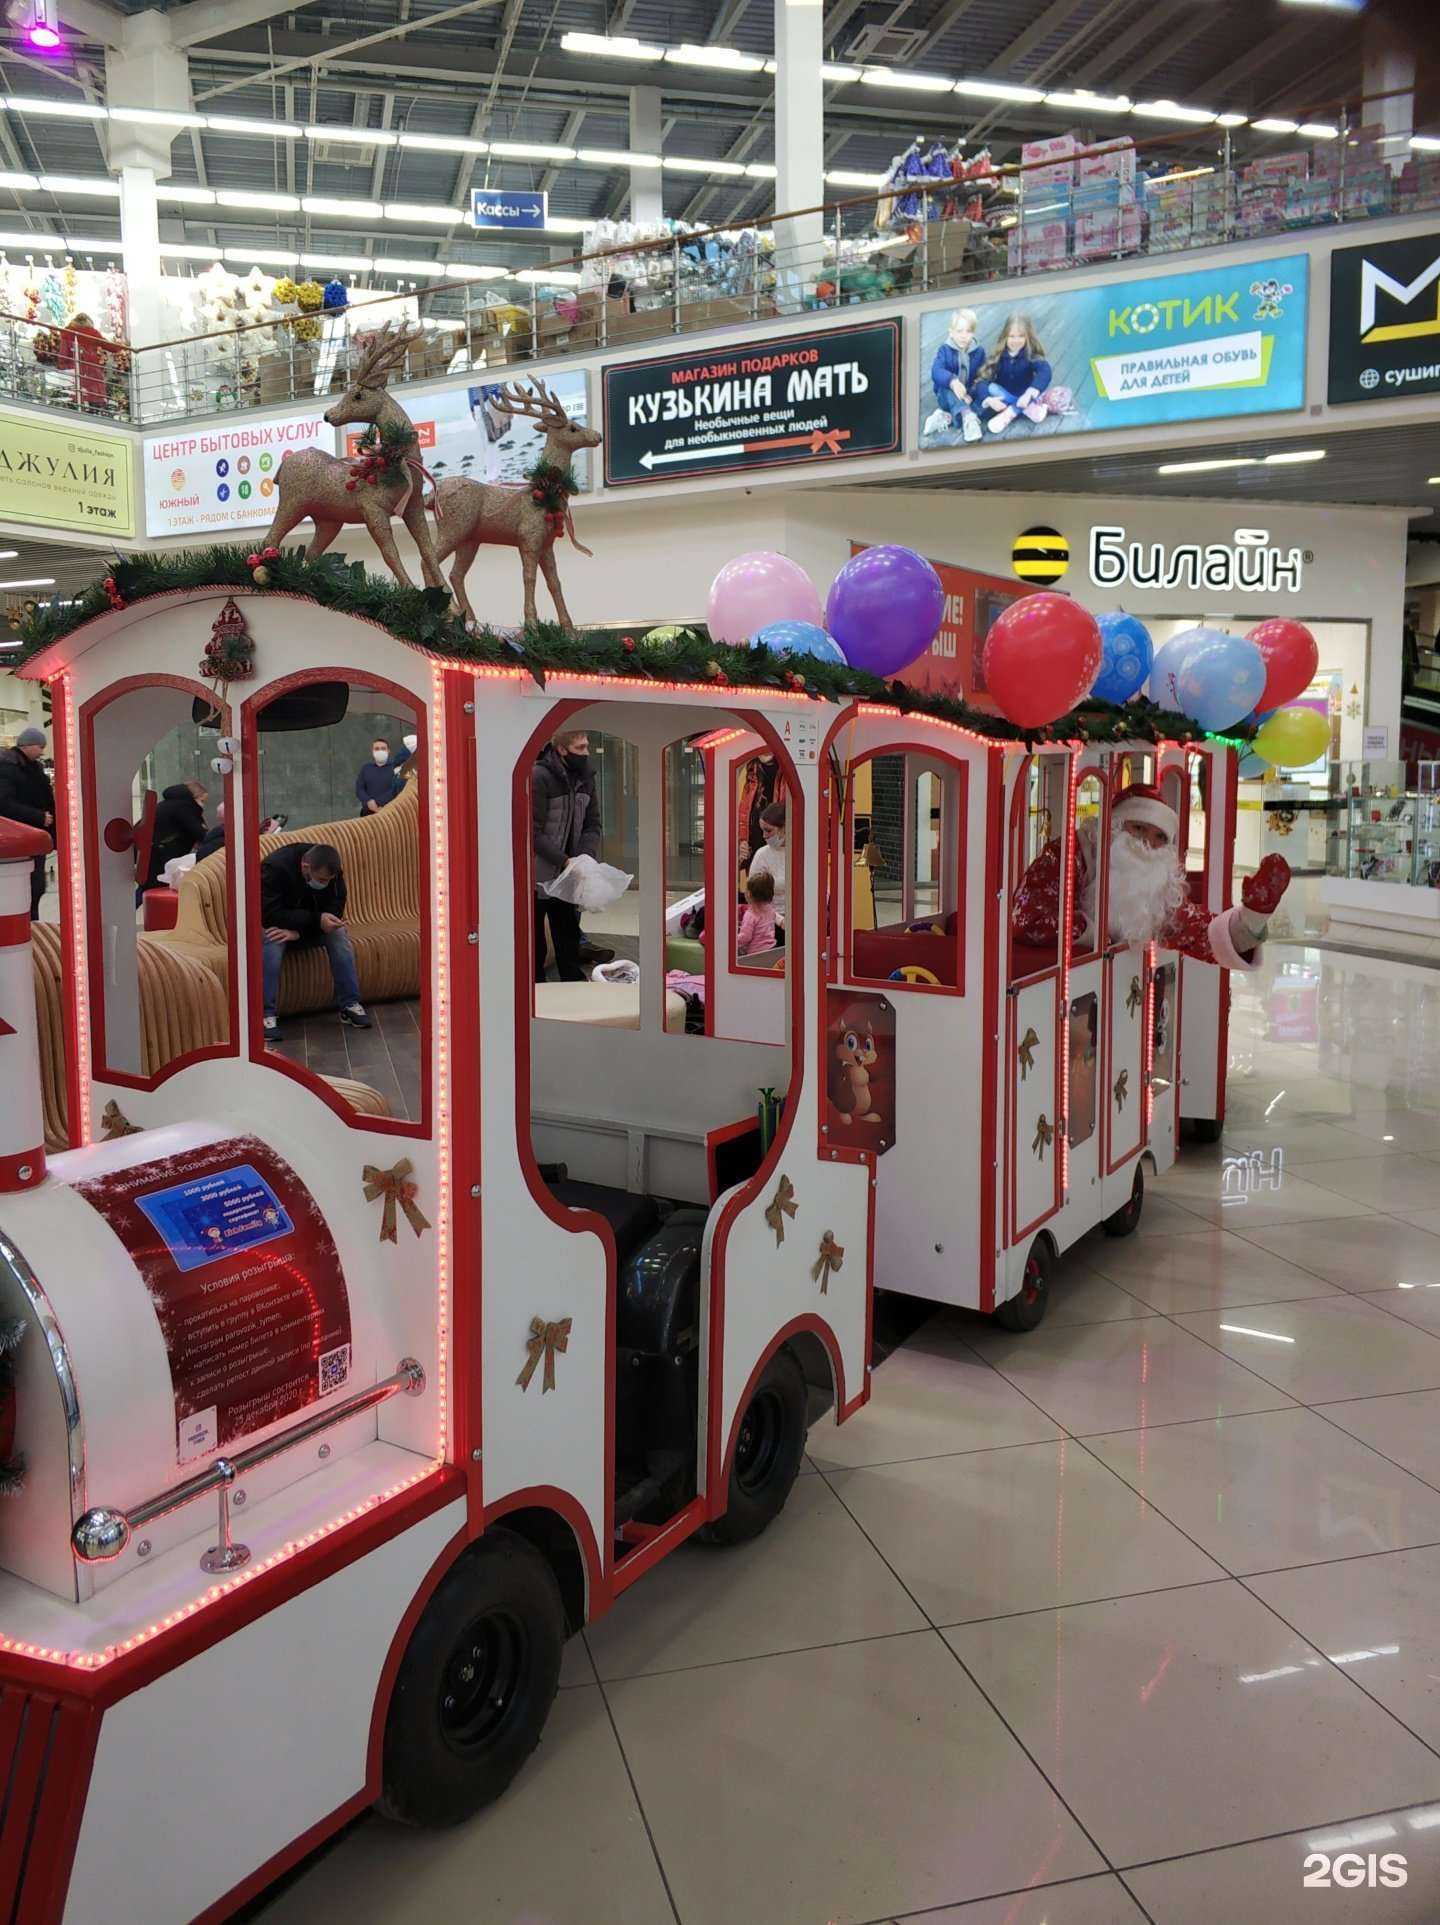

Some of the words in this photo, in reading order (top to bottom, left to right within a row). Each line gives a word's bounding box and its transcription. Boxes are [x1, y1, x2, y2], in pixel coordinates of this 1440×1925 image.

[476, 202, 520, 217] Кассы
[1109, 291, 1240, 337] КОТИК
[671, 364, 737, 385] МАГАЗИН
[741, 349, 820, 372] ПОДАРКОВ
[1120, 353, 1209, 375] ПРАВИЛЬНАЯ
[1212, 349, 1258, 365] ОБУВЬ
[628, 375, 772, 426] КУЗЬКИНА
[787, 361, 870, 403] МАТЬ
[1120, 377, 1148, 392] ДЛЯ
[1150, 370, 1191, 388] ДЕТЕЙ
[664, 437, 685, 450] для
[687, 425, 786, 446] необыкновенных
[788, 416, 829, 432] людей
[694, 414, 761, 432] Необычные
[763, 408, 796, 421] вещи
[153, 440, 198, 461] ЦЕНТР
[200, 428, 273, 453] БЫТОВЫХ
[277, 420, 324, 442] УСЛУГ
[78, 501, 84, 514] 1
[87, 505, 117, 519] этаж
[159, 493, 200, 510] ЮЖНЫЙ
[200, 511, 229, 525] РЯДОМ
[1089, 525, 1302, 593] Билайн
[118, 1167, 178, 1192] ВНИМАНИЕ
[179, 1150, 242, 1173] РОЗЫГРЫШ
[184, 1186, 201, 1197] 1000
[201, 1180, 225, 1192] рублей
[218, 1184, 241, 1197] рублей
[242, 1190, 264, 1203] рублей
[200, 1273, 241, 1295] Условия
[243, 1253, 296, 1281] розыгрыша:
[184, 1304, 228, 1326] прокатиться
[187, 1322, 219, 1341] вступить
[226, 1311, 249, 1326] группу
[255, 1294, 291, 1312] ВКонтакте
[194, 1350, 226, 1369] написать
[227, 1340, 249, 1356] номер
[249, 1330, 274, 1345] билета
[197, 1381, 225, 1399] сделать
[226, 1369, 250, 1386] репост
[228, 1392, 272, 1416] Розыгрыш
[272, 1375, 309, 1395] состоится
[244, 1400, 278, 1424] декабря
[279, 1390, 298, 1406] 2020
